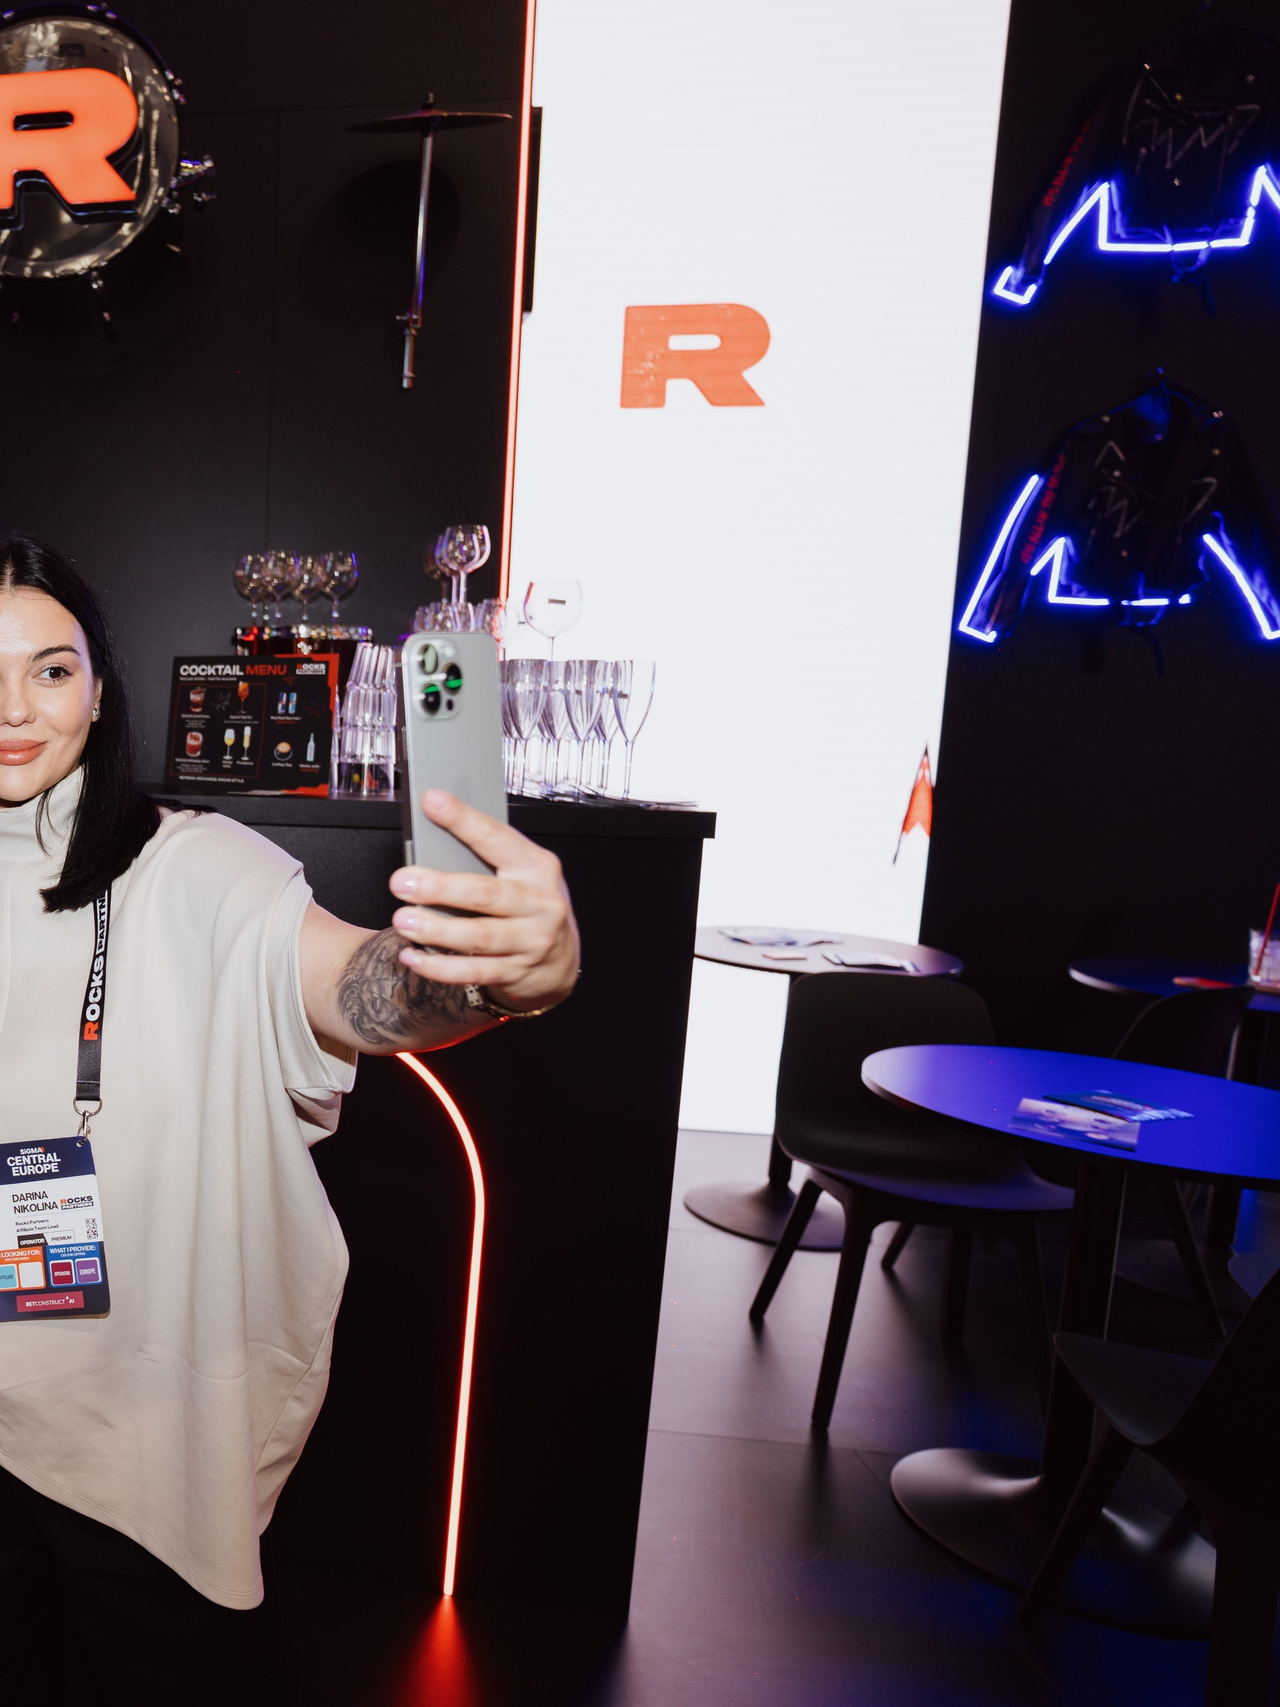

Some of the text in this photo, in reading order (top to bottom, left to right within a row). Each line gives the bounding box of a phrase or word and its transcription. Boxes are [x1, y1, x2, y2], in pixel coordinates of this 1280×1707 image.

[620, 303, 771, 409] R
[180, 664, 287, 676] COCKTAIL MENU
[83, 896, 107, 1041] ROCKS PARTN
[7, 1153, 61, 1166] CENTRAL
[12, 1163, 59, 1176] EUROPE
[12, 1191, 48, 1202] DARINA
[60, 1196, 93, 1204] ROCKS
[14, 1201, 58, 1214] NIKOLINA
[1, 1250, 27, 1258] LOOKING
[49, 1246, 66, 1254] WHAT
[26, 1299, 65, 1307] BETCONSTRUCT
